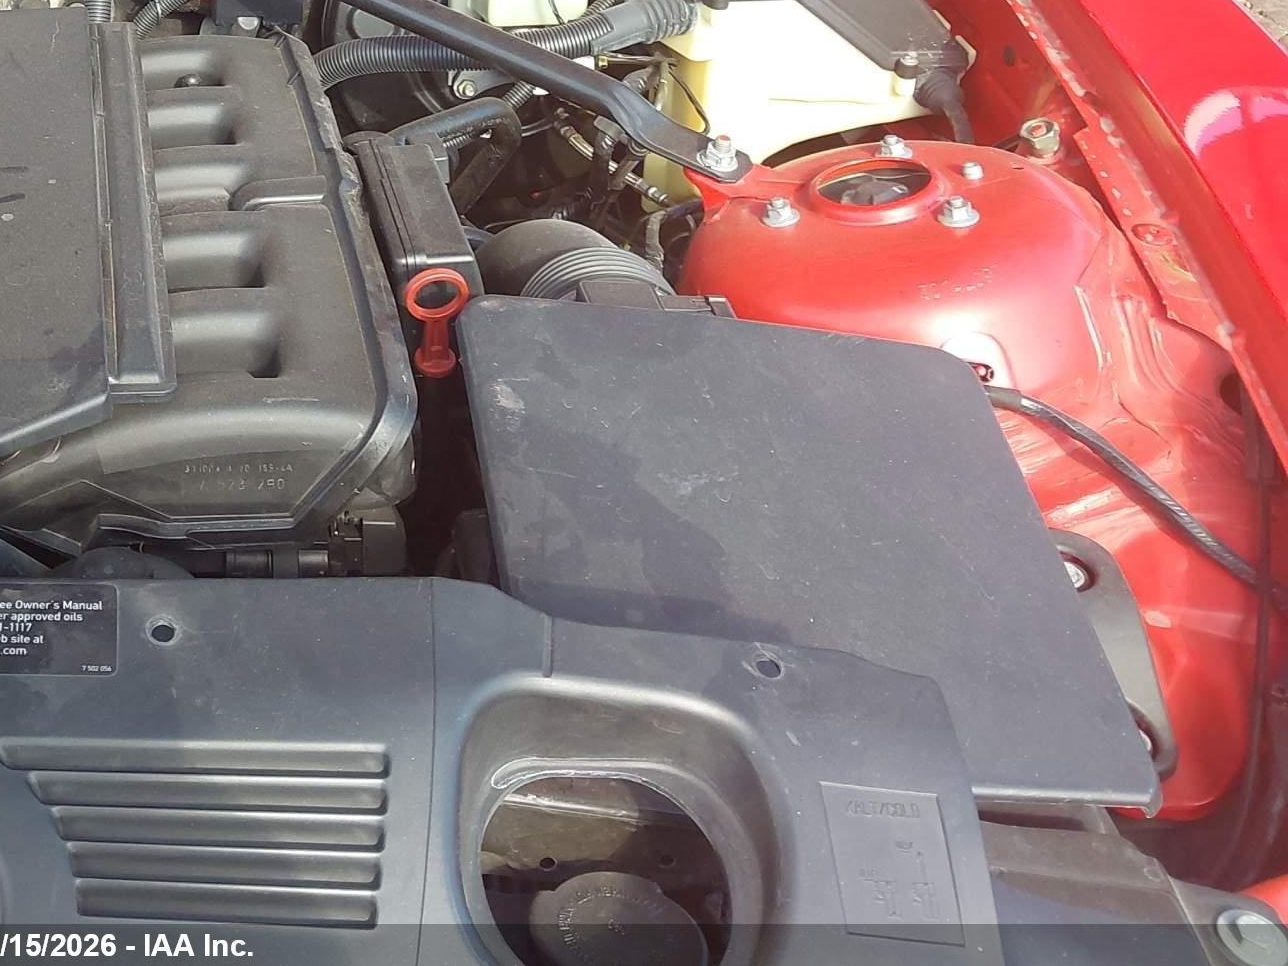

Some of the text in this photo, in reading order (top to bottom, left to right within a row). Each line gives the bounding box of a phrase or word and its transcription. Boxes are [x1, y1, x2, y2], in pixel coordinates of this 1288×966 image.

[62, 600, 103, 611] Manual
[11, 612, 61, 622] approved
[63, 612, 83, 621] oils
[11, 634, 30, 644] site
[33, 636, 44, 644] at
